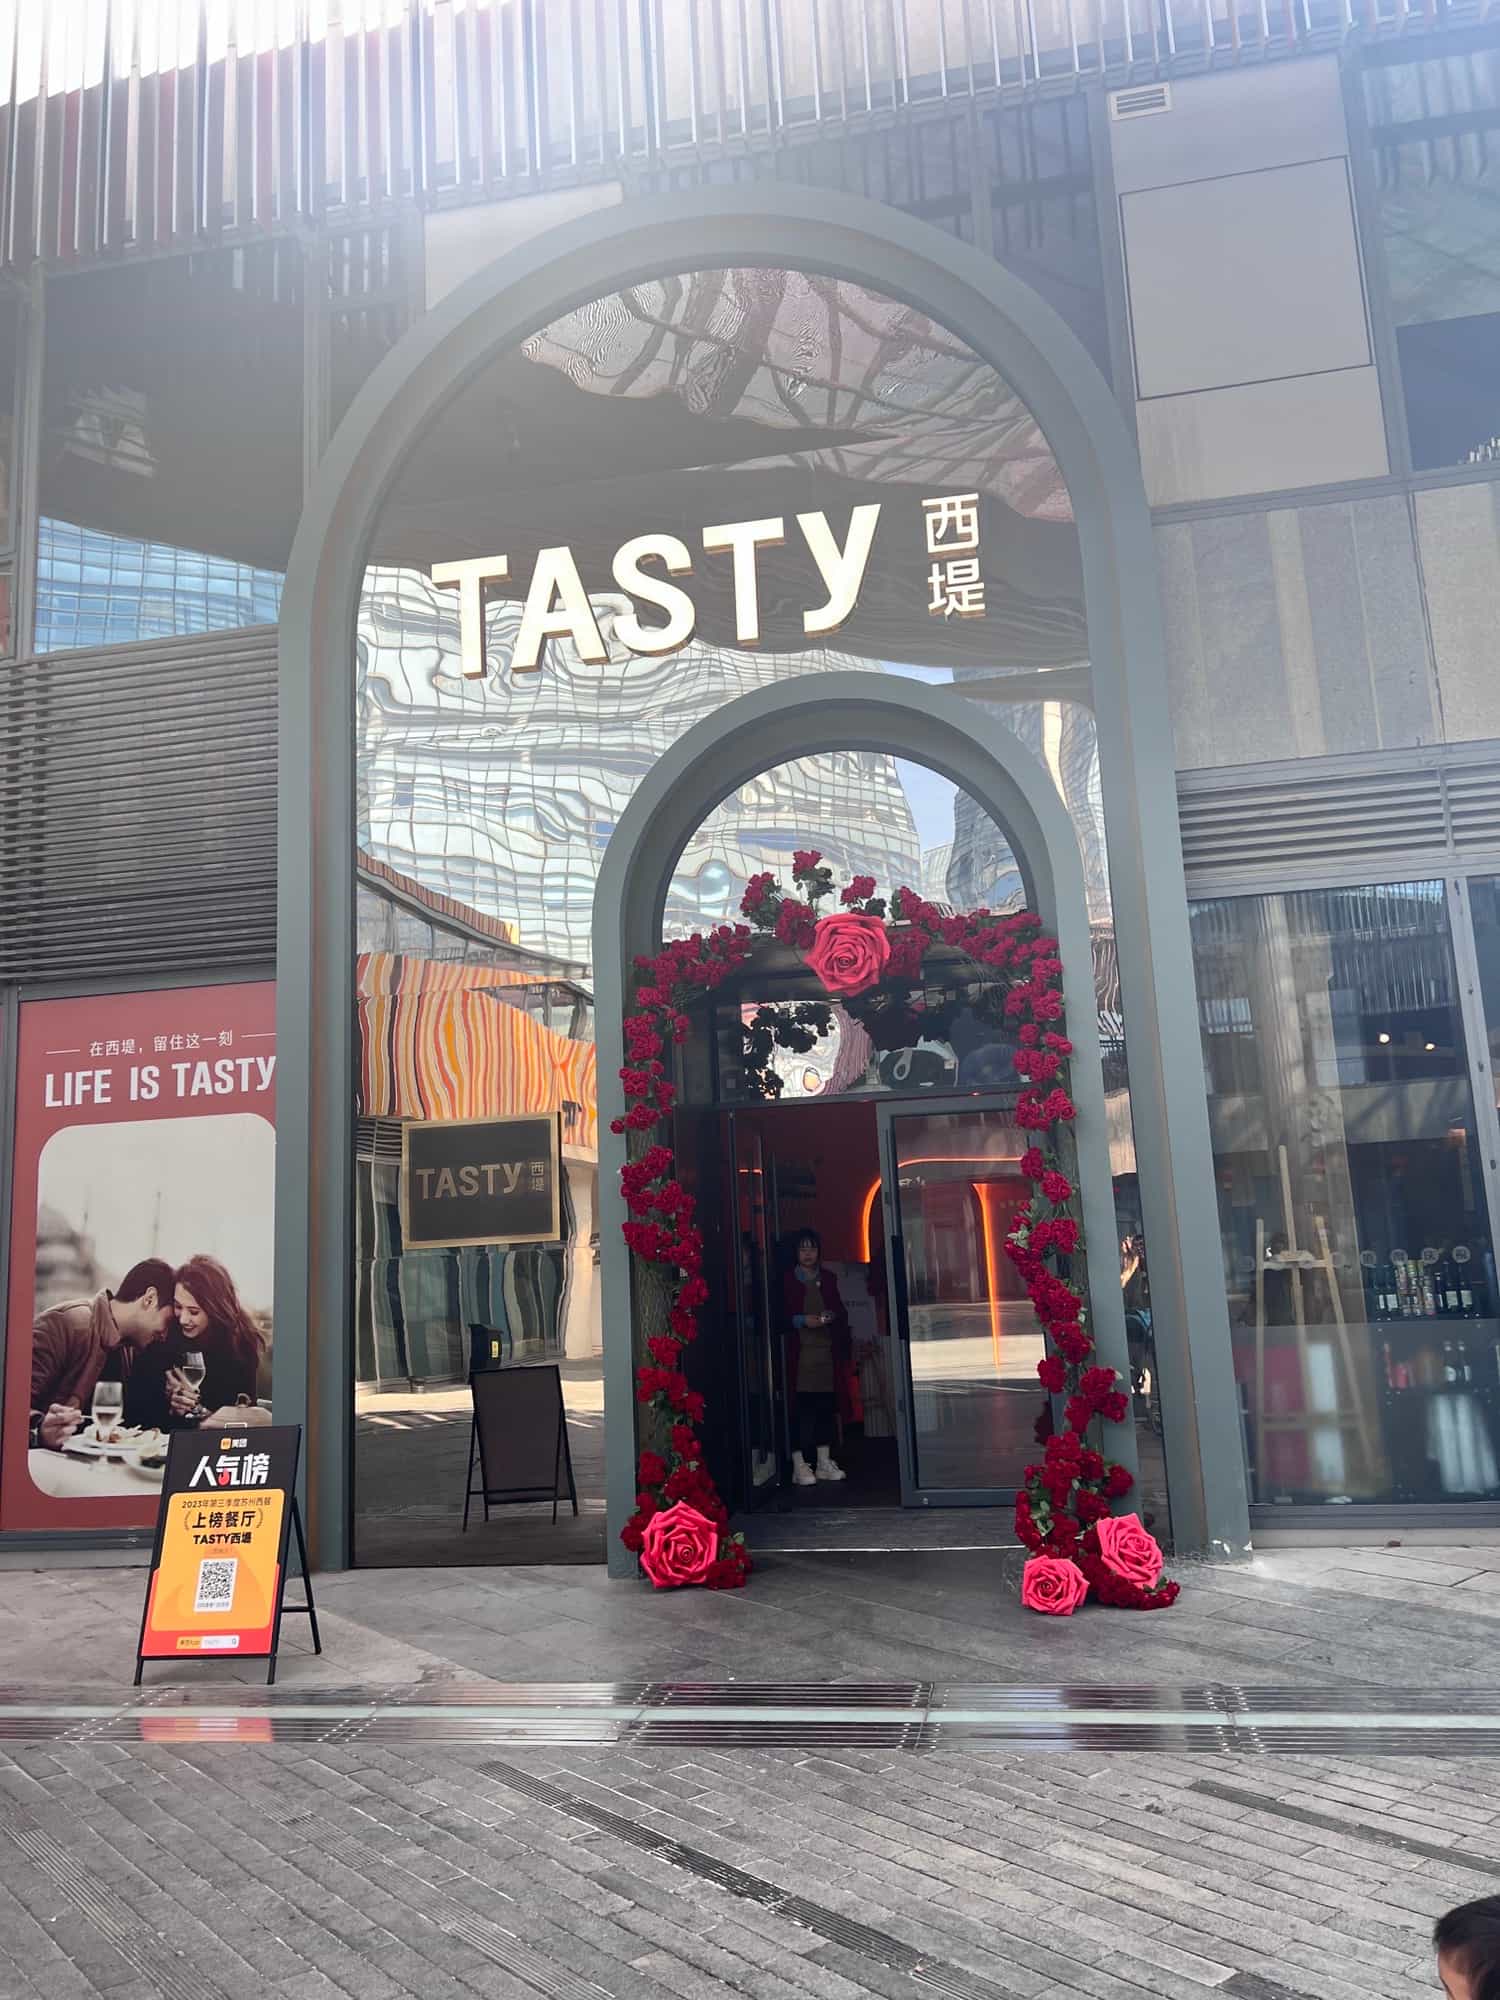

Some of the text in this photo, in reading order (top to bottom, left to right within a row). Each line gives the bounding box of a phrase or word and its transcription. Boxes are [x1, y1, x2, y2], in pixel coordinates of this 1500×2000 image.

[921, 492, 987, 618] 西堤
[45, 1069, 112, 1108] LIFE
[130, 1065, 160, 1101] IS
[189, 1454, 271, 1486] 人气榜
[192, 1510, 257, 1529] 上榜餐厅
